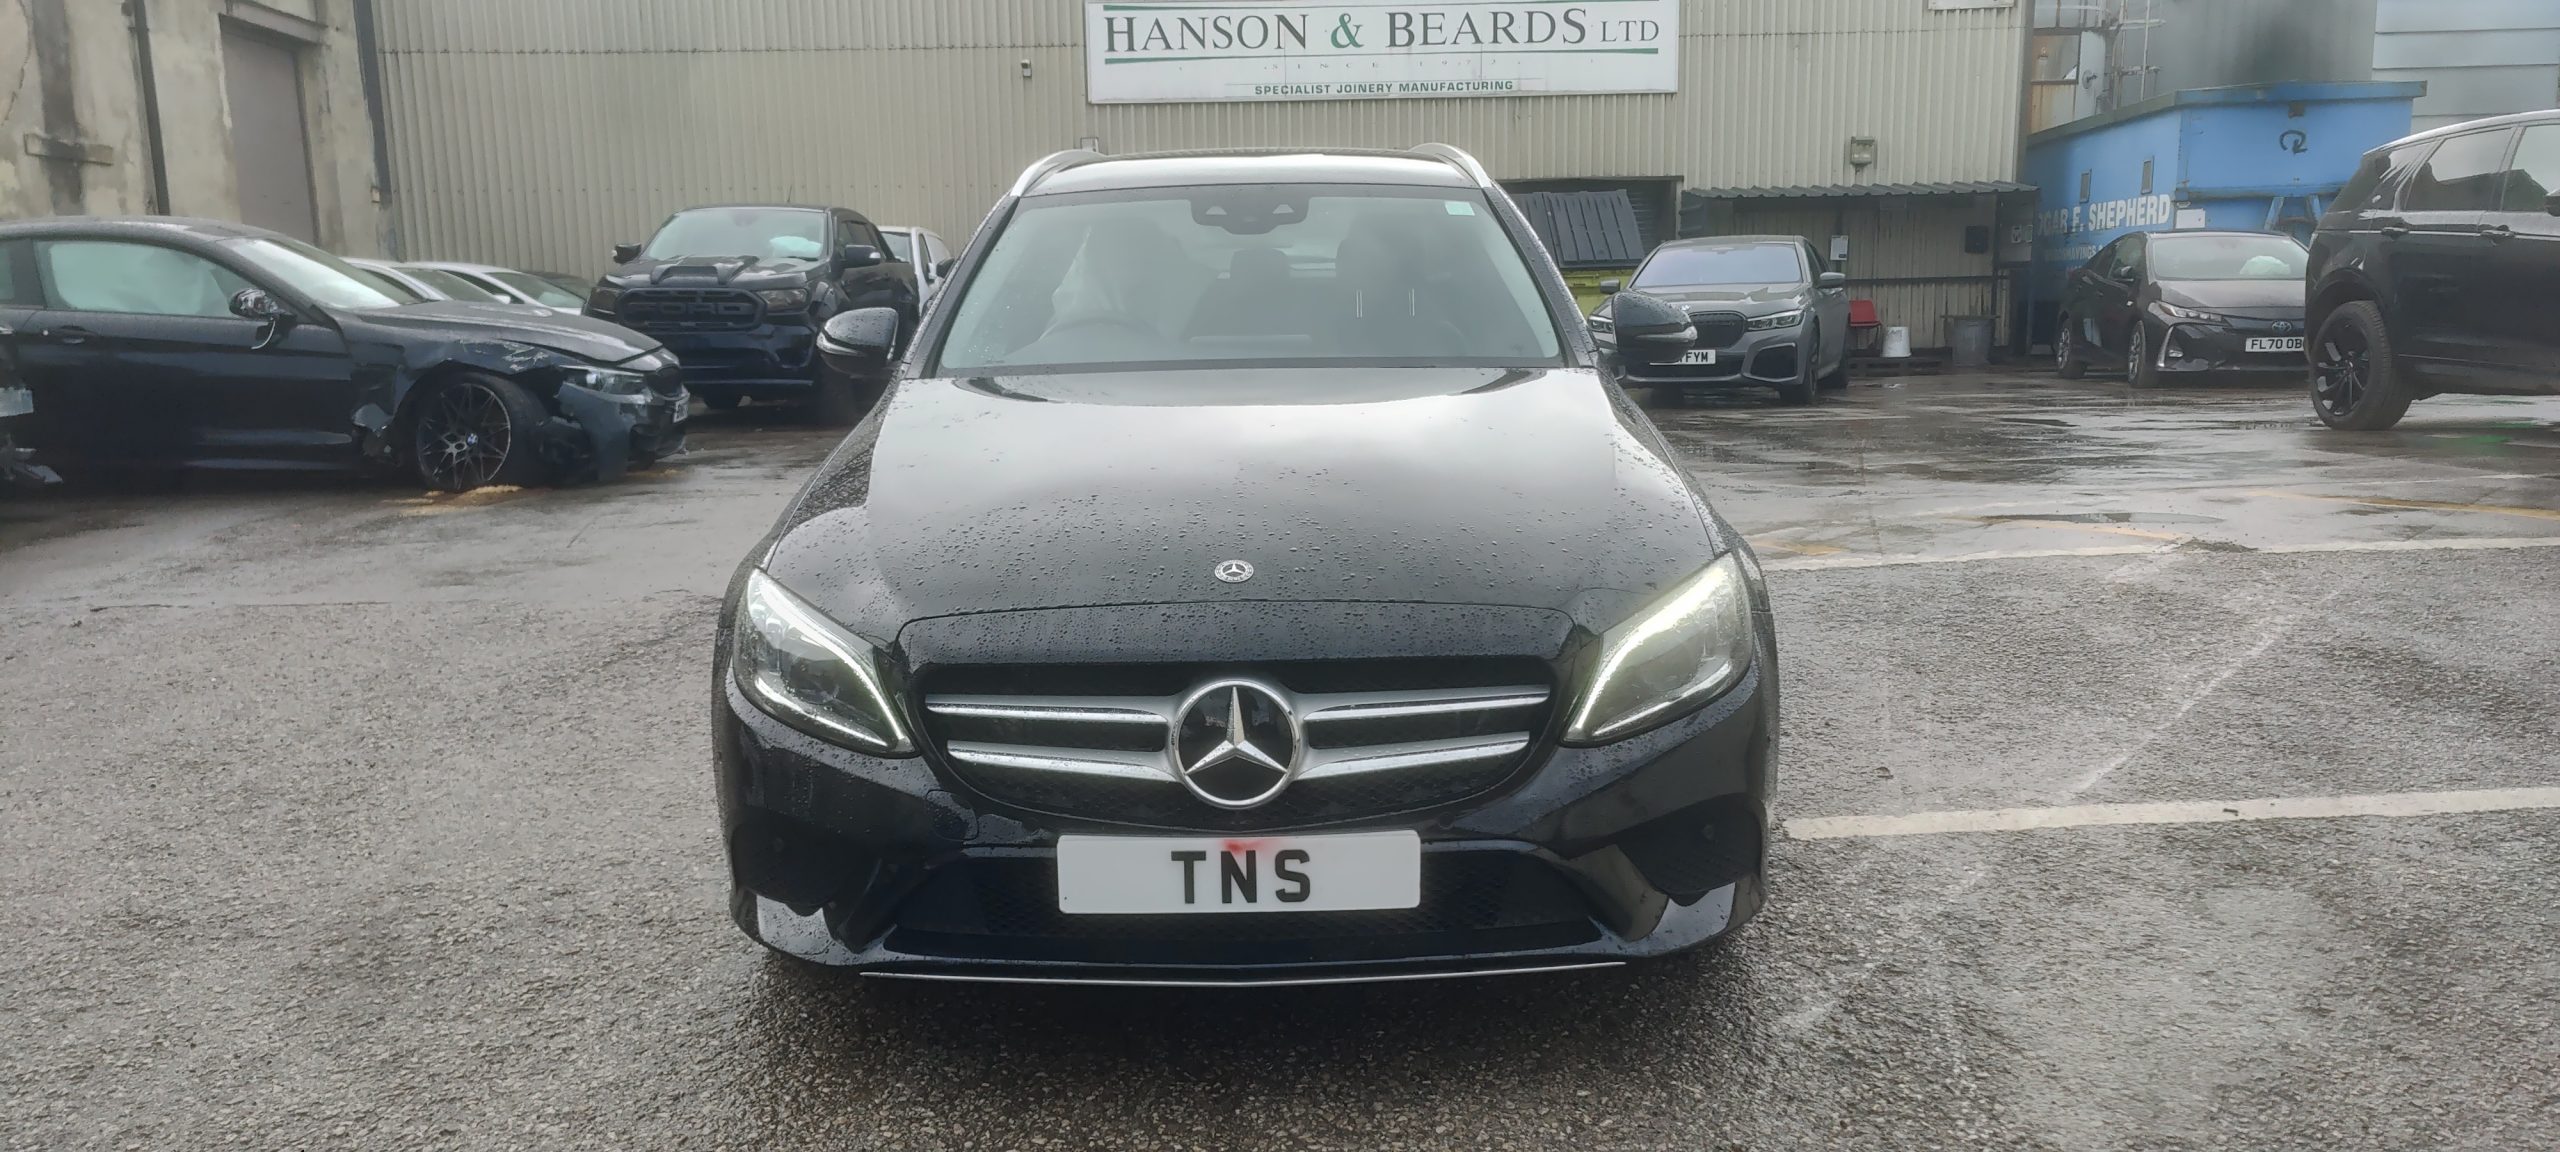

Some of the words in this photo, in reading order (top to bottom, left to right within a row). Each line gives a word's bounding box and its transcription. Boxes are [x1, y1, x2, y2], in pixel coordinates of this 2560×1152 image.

[1104, 14, 1309, 52] HANSON
[1330, 13, 1364, 49] &
[1385, 8, 1587, 48] BEARDS
[1600, 20, 1659, 42] LTD
[1255, 84, 1331, 96] SPECIALIST
[1336, 83, 1393, 94] JOINERY
[1399, 80, 1513, 93] MANUFACTURING
[2088, 193, 2171, 231] SHEPHERD
[2251, 339, 2283, 350] FL70
[2286, 338, 2304, 349] OB
[1171, 849, 1311, 904] TNS
